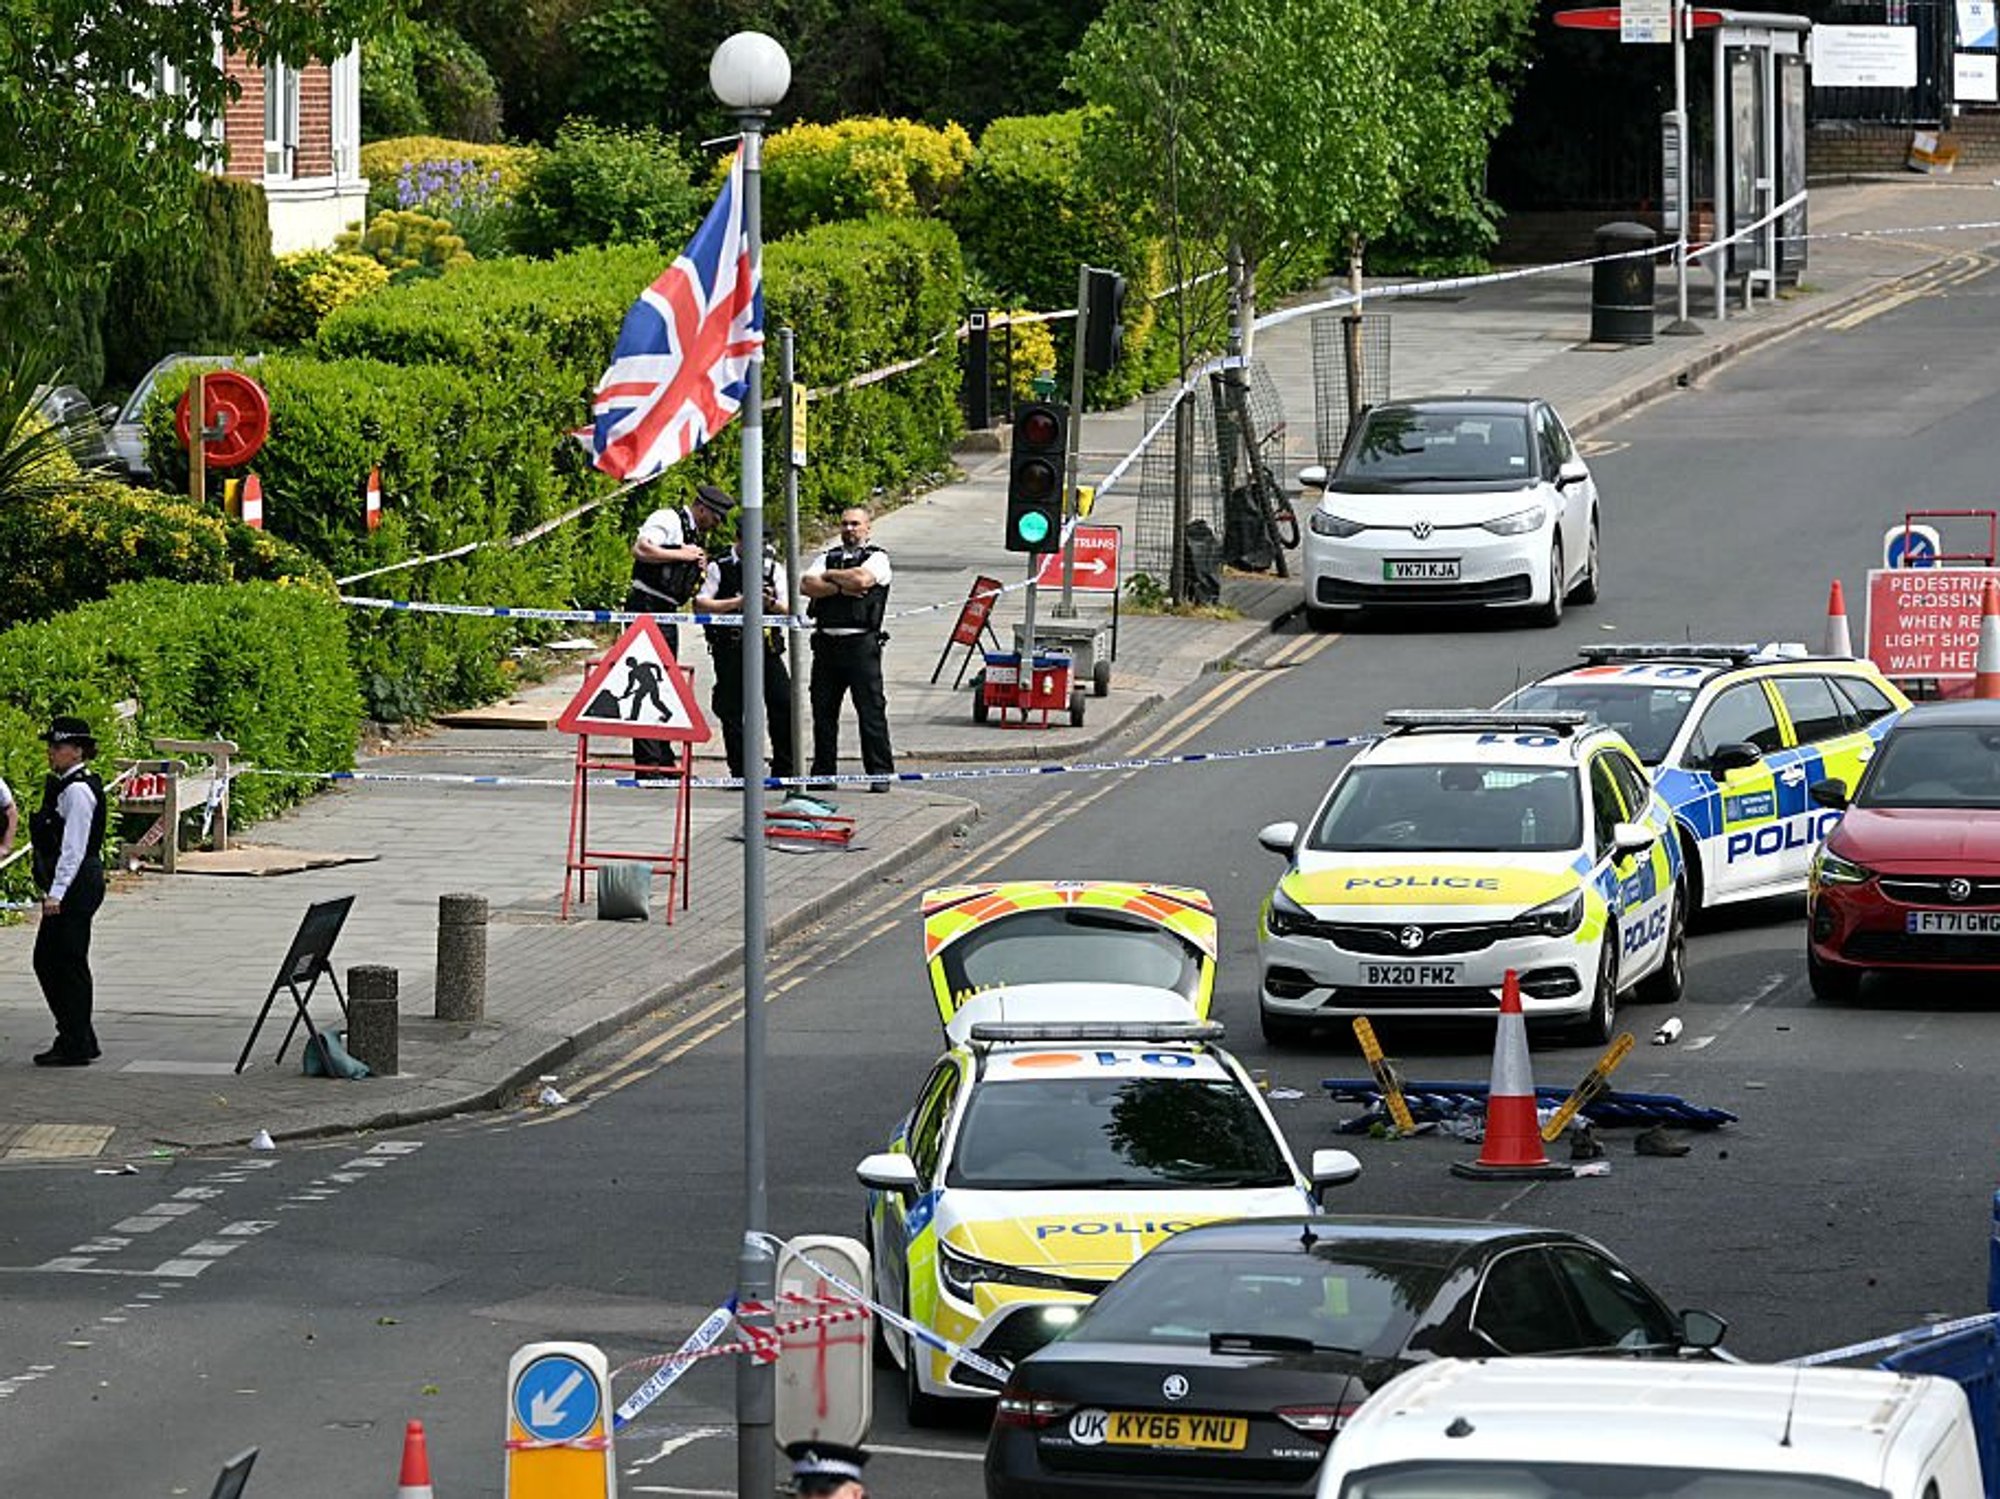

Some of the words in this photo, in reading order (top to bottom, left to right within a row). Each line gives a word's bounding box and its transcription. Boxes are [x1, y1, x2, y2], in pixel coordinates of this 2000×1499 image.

[1396, 564, 1426, 576] VK71
[1429, 564, 1455, 576] KJA
[1898, 593, 1982, 607] CROSSIN
[1899, 614, 1953, 629] WHEN
[1959, 614, 1981, 629] RE
[1885, 634, 1936, 648] LIGHT
[1941, 632, 1980, 647] SHO
[1890, 655, 1933, 668] WAIT
[1940, 651, 1977, 668] HE
[1727, 812, 1844, 864] POLIC
[1345, 876, 1499, 890] POLICE
[1623, 903, 1667, 959] POLICE
[1368, 966, 1415, 984] BX20
[1420, 966, 1455, 984] FMZ
[1036, 1221, 1194, 1239] POLIC
[1075, 1414, 1108, 1438] UK
[1116, 1416, 1180, 1439] KY66
[1189, 1418, 1236, 1443] YNU
